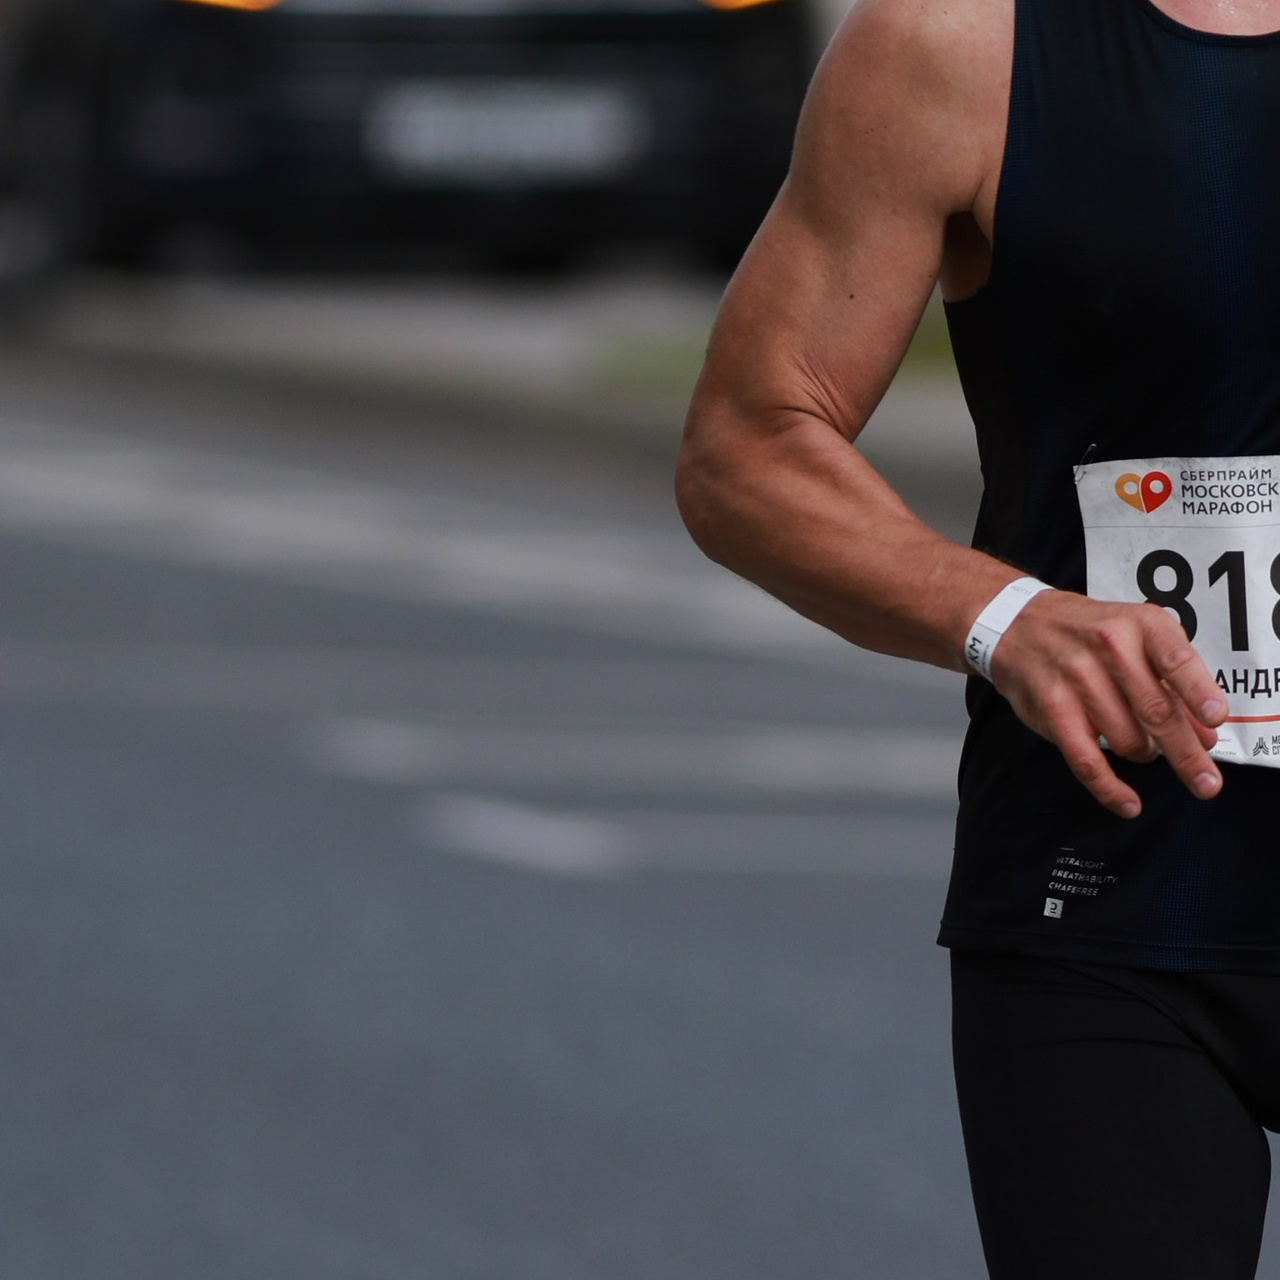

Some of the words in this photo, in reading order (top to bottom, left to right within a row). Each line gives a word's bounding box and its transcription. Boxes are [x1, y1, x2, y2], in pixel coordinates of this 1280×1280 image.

[1180, 467, 1272, 482] СБЕРПРАЙМ
[1182, 500, 1273, 516] МАРАФОН
[1051, 869, 1118, 884] BREATHABILITY
